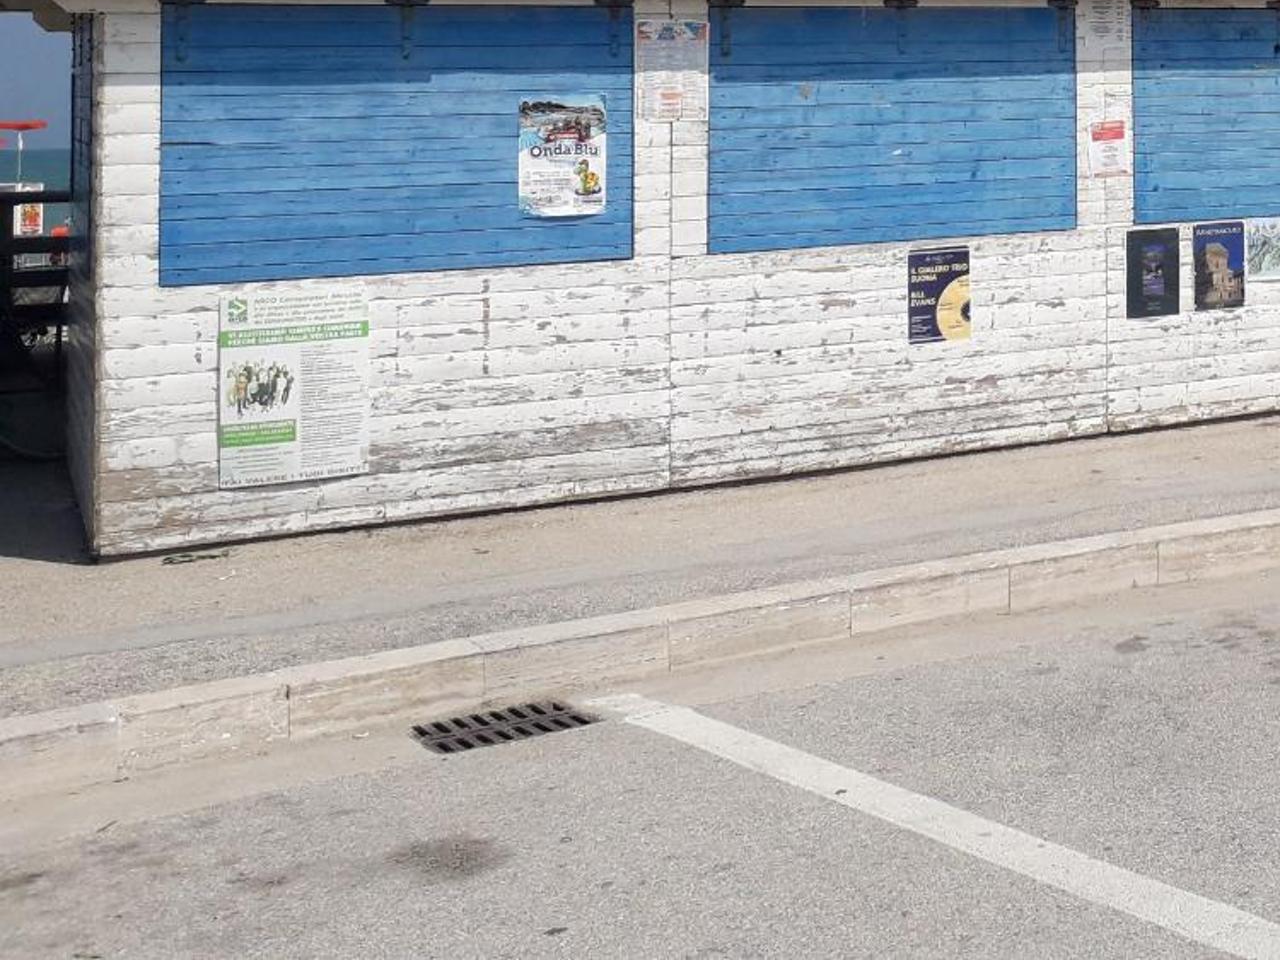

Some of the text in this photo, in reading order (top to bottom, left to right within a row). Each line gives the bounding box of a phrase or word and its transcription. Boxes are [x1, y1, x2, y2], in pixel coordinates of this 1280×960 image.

[530, 143, 598, 158] Onda Blu
[911, 298, 936, 307] EVANS
